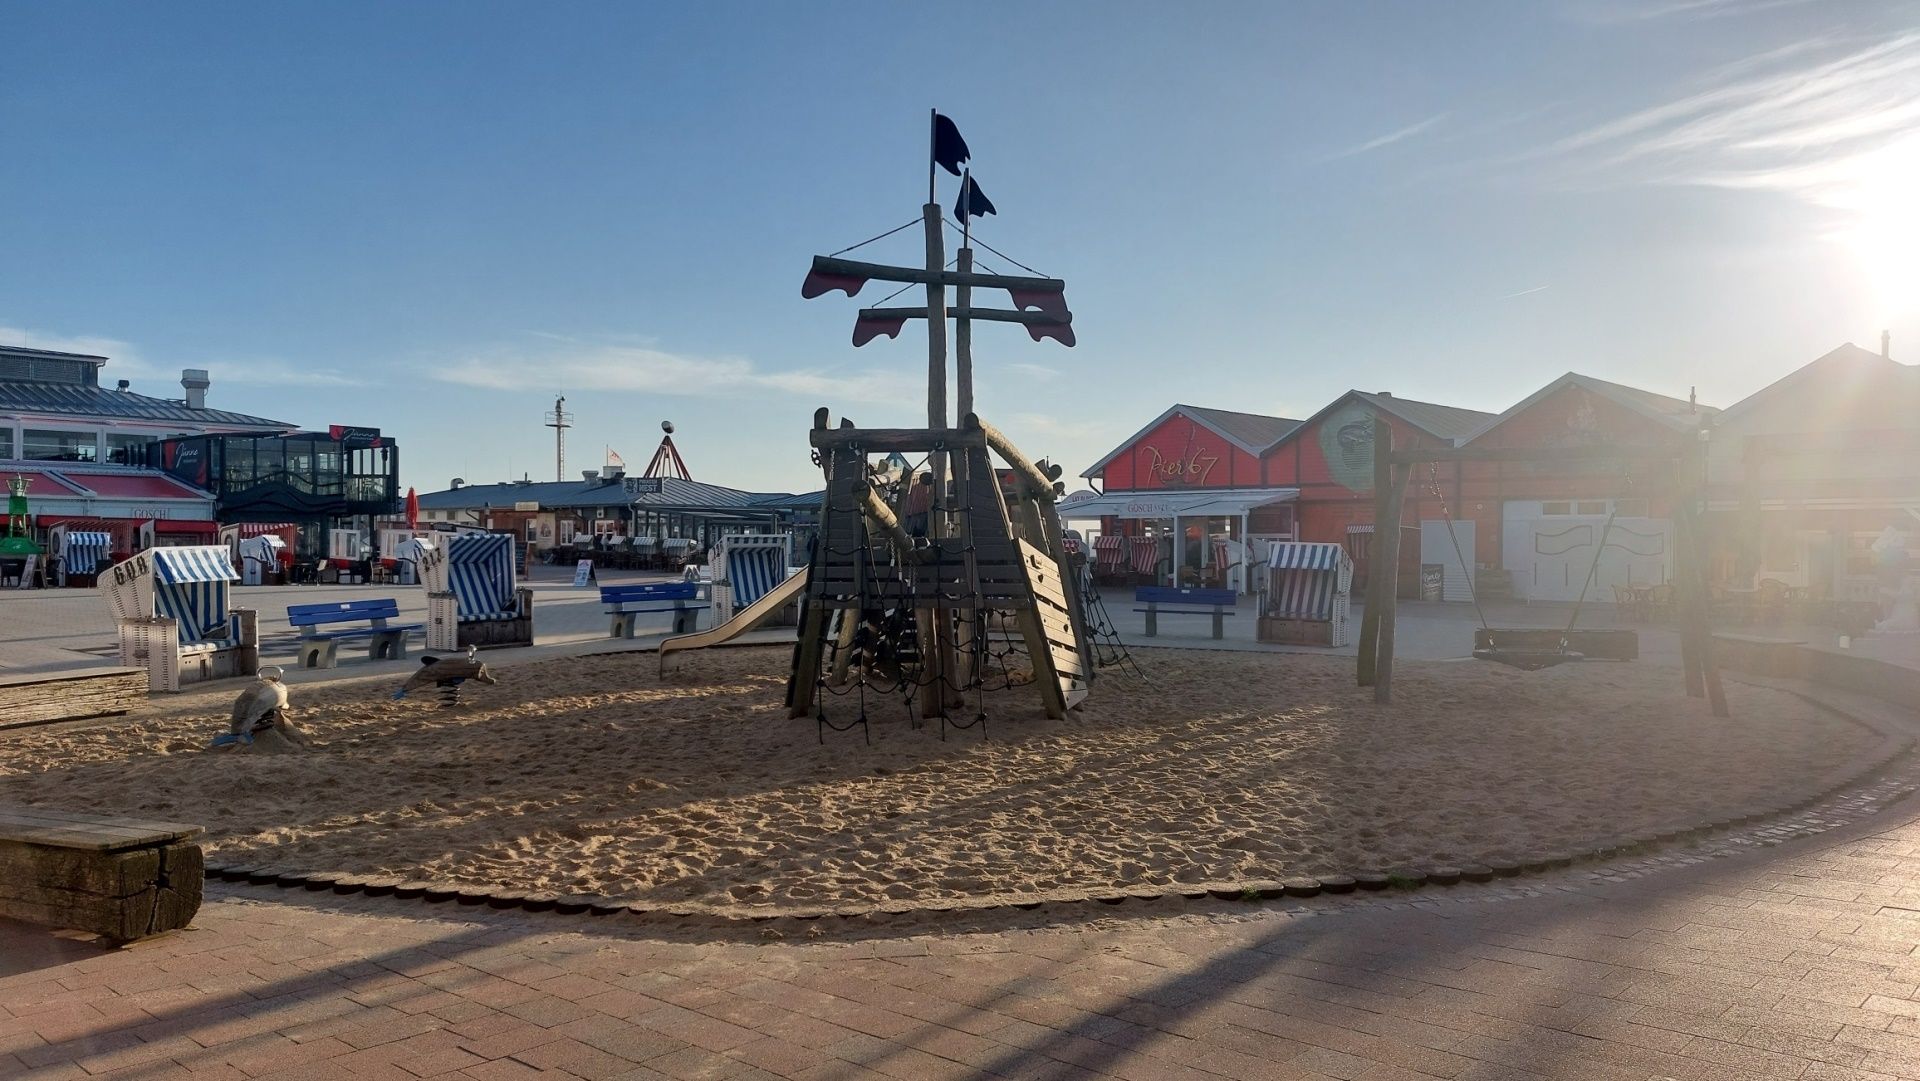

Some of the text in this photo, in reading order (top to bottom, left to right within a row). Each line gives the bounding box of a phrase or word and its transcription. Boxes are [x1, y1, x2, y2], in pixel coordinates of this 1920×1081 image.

[1141, 445, 1218, 490] Pier 67
[1127, 503, 1153, 513] GOSCH
[134, 509, 166, 519] GOSCH
